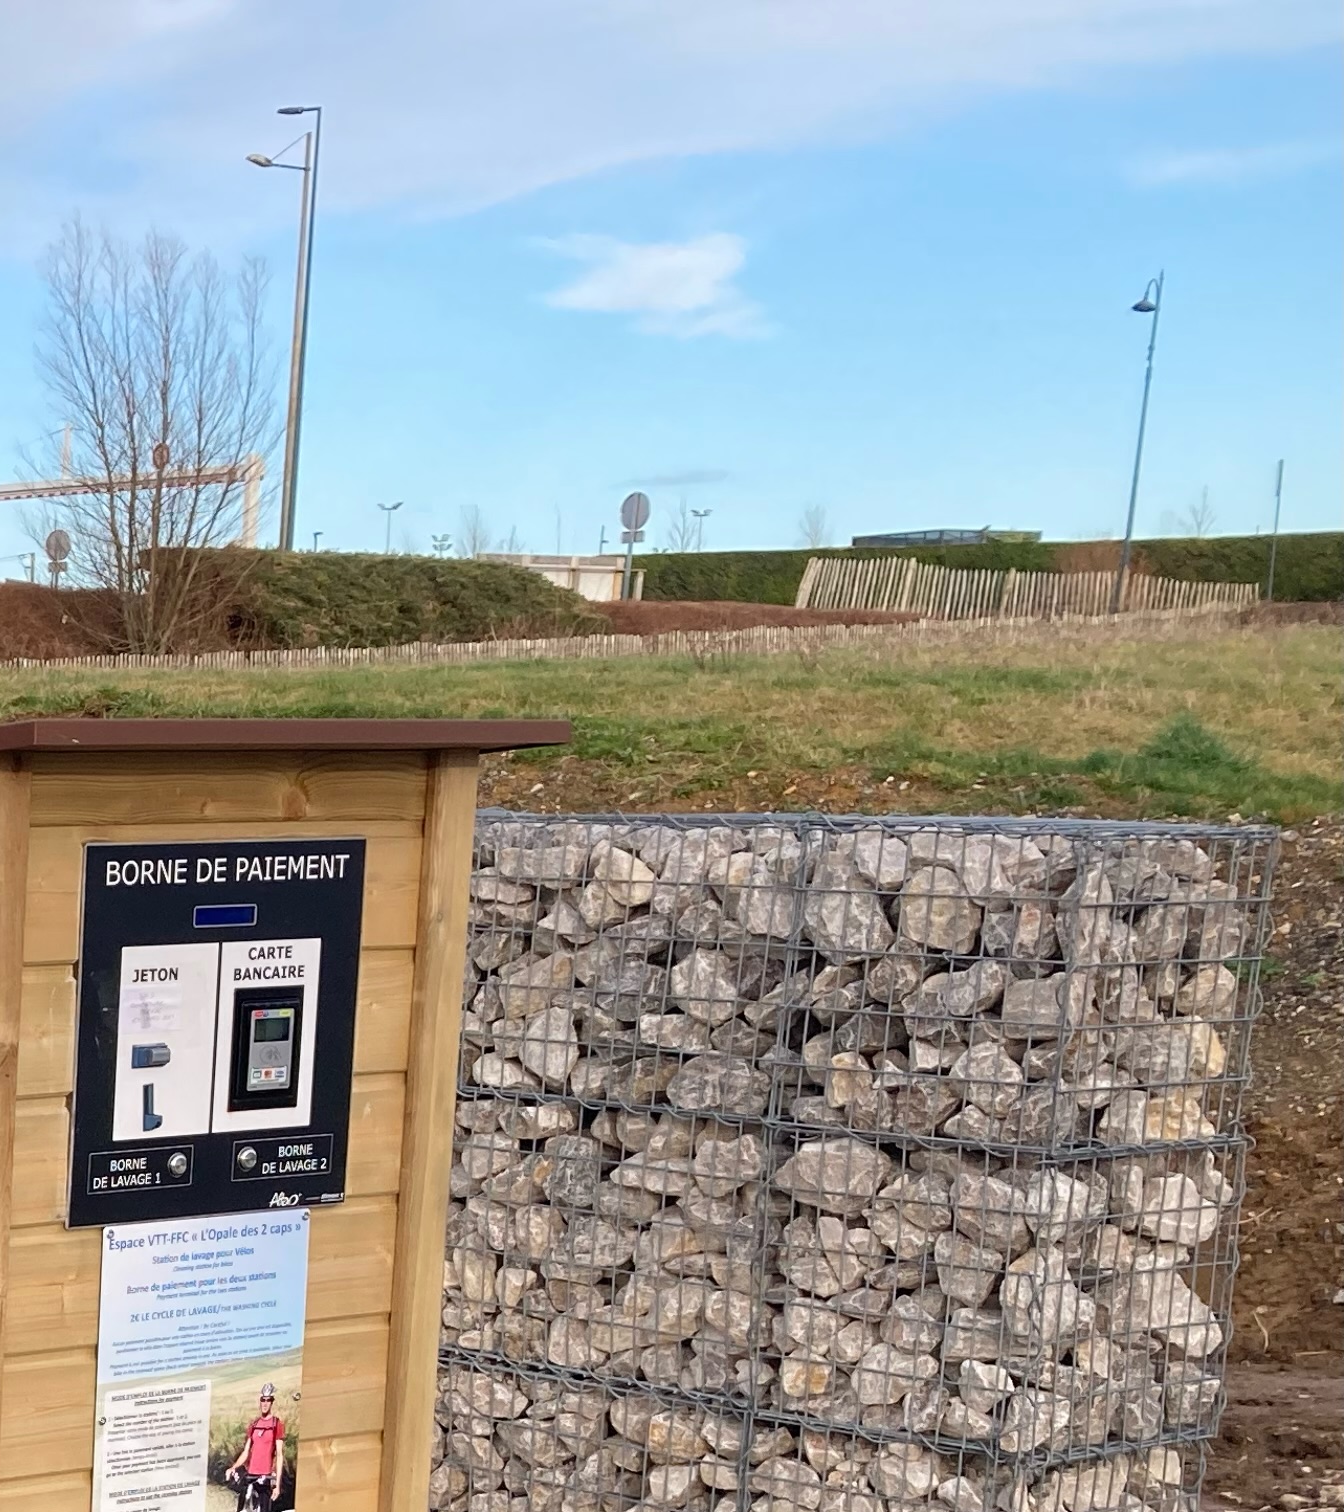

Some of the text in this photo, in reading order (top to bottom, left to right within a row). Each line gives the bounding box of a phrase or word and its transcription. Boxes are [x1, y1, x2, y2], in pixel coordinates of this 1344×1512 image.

[106, 854, 350, 886] BORNE DE PAIEMENT
[248, 945, 293, 960] CARTE
[132, 967, 179, 983] JETON
[233, 965, 305, 981] BANCAIRE
[278, 1143, 313, 1157] BORNE
[110, 1157, 147, 1172] BORNE
[262, 1157, 327, 1175] DE LAVAGE 2
[93, 1172, 161, 1190] DE LAVAGE 1
[109, 1238, 145, 1252] Espace
[148, 1231, 189, 1246] VTT-FFC
[201, 1226, 238, 1242] L'Opale
[241, 1224, 258, 1237] des
[261, 1223, 267, 1235] 2
[270, 1223, 292, 1236] caps
[152, 1254, 178, 1264] Station
[180, 1253, 189, 1262] de
[192, 1250, 214, 1260] lavage
